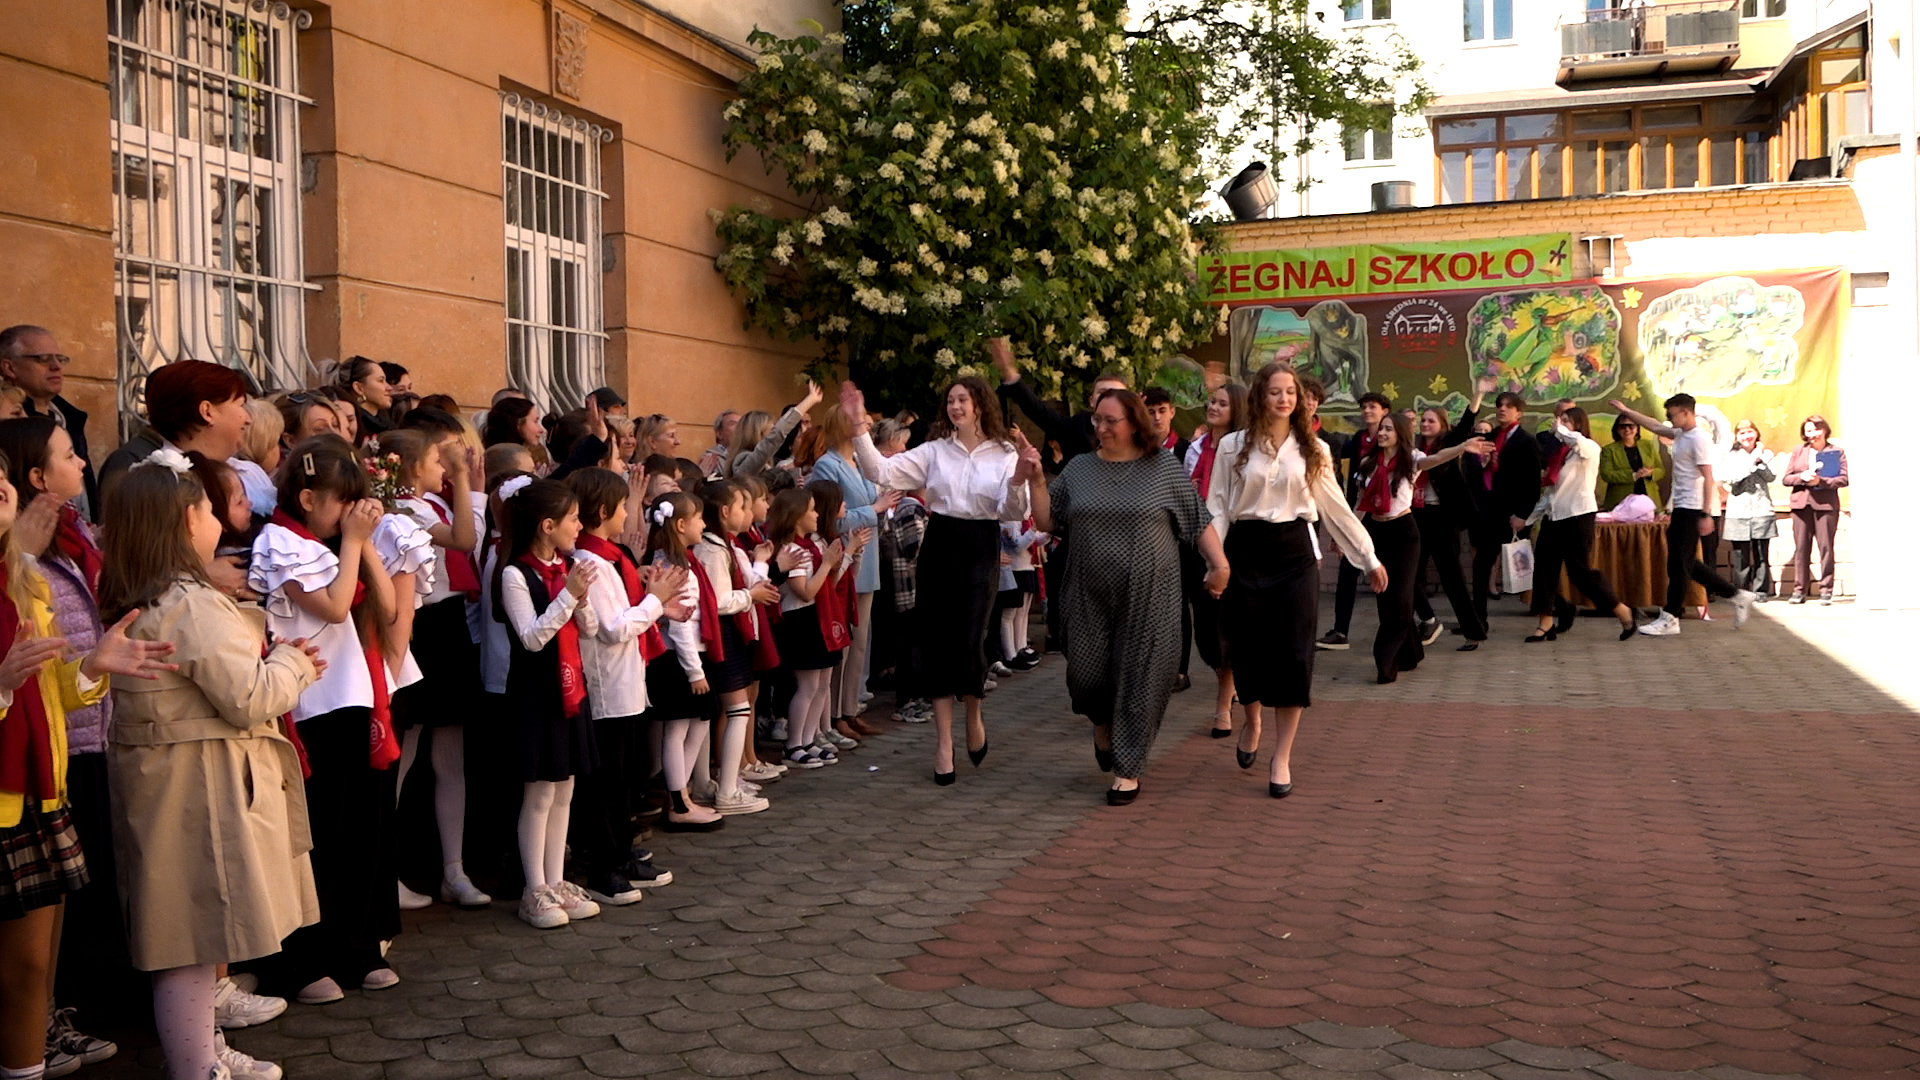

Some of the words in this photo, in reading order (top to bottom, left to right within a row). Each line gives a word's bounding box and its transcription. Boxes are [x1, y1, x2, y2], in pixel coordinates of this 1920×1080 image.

[1207, 258, 1355, 294] ŻEGNAJ
[1369, 248, 1535, 285] SZKOŁO
[1428, 299, 1439, 309] 24
